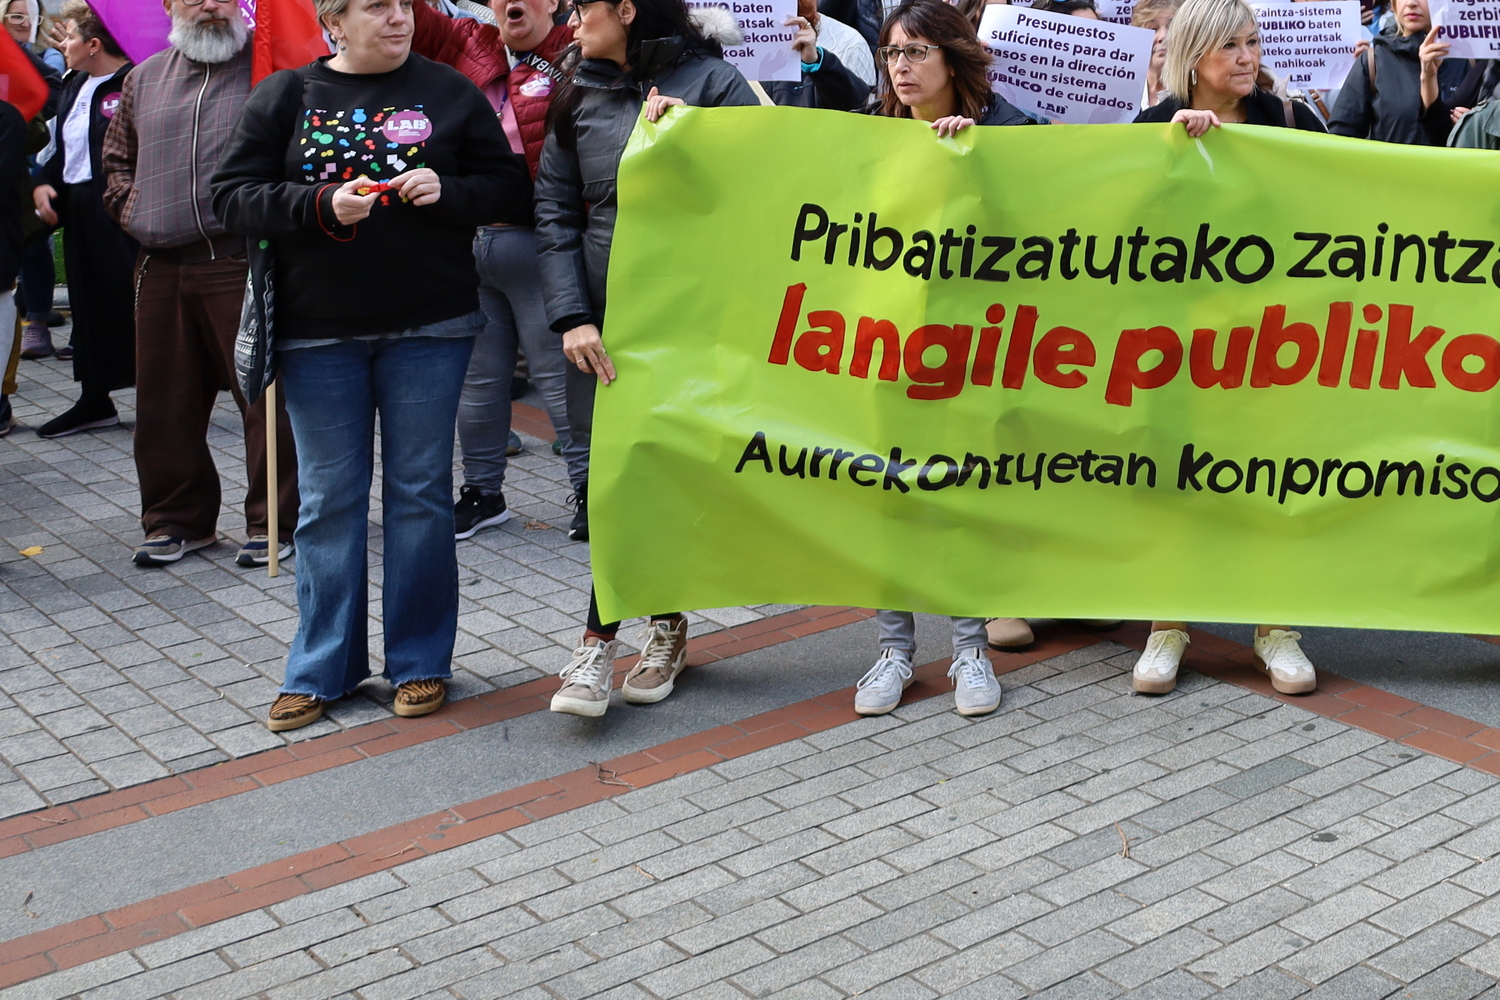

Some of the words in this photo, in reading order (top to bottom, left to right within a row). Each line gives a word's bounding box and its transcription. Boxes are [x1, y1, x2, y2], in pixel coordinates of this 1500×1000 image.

[733, 2, 773, 13] baten
[738, 18, 774, 29] atsak
[1017, 13, 1115, 41] Presupuestos
[1308, 20, 1341, 29] baten
[743, 32, 793, 43] ekontu
[1259, 33, 1294, 43] ldeko
[1296, 33, 1342, 42] urratsak
[991, 29, 1069, 51] suficientes
[1073, 44, 1106, 58] para
[1110, 48, 1135, 63] dar
[1261, 46, 1292, 56] ateko
[1294, 45, 1356, 56] aurrekontu
[1030, 54, 1048, 65] en
[1052, 55, 1065, 68] la
[1068, 59, 1136, 80] dirección
[1274, 58, 1326, 69] nahikoak
[1008, 65, 1027, 76] de
[1030, 70, 1048, 80] un
[1051, 72, 1107, 91] sistema
[1289, 72, 1312, 83] LAB
[987, 70, 1042, 93] ÚBLICO
[1045, 87, 1064, 98] de
[1067, 90, 1134, 111] cuidados
[1037, 101, 1068, 114] LAB
[387, 118, 429, 131] LAB
[790, 202, 1276, 285] Pribatizatutako
[768, 282, 1097, 400] langile
[734, 430, 1158, 494] Aurrekontuetan
